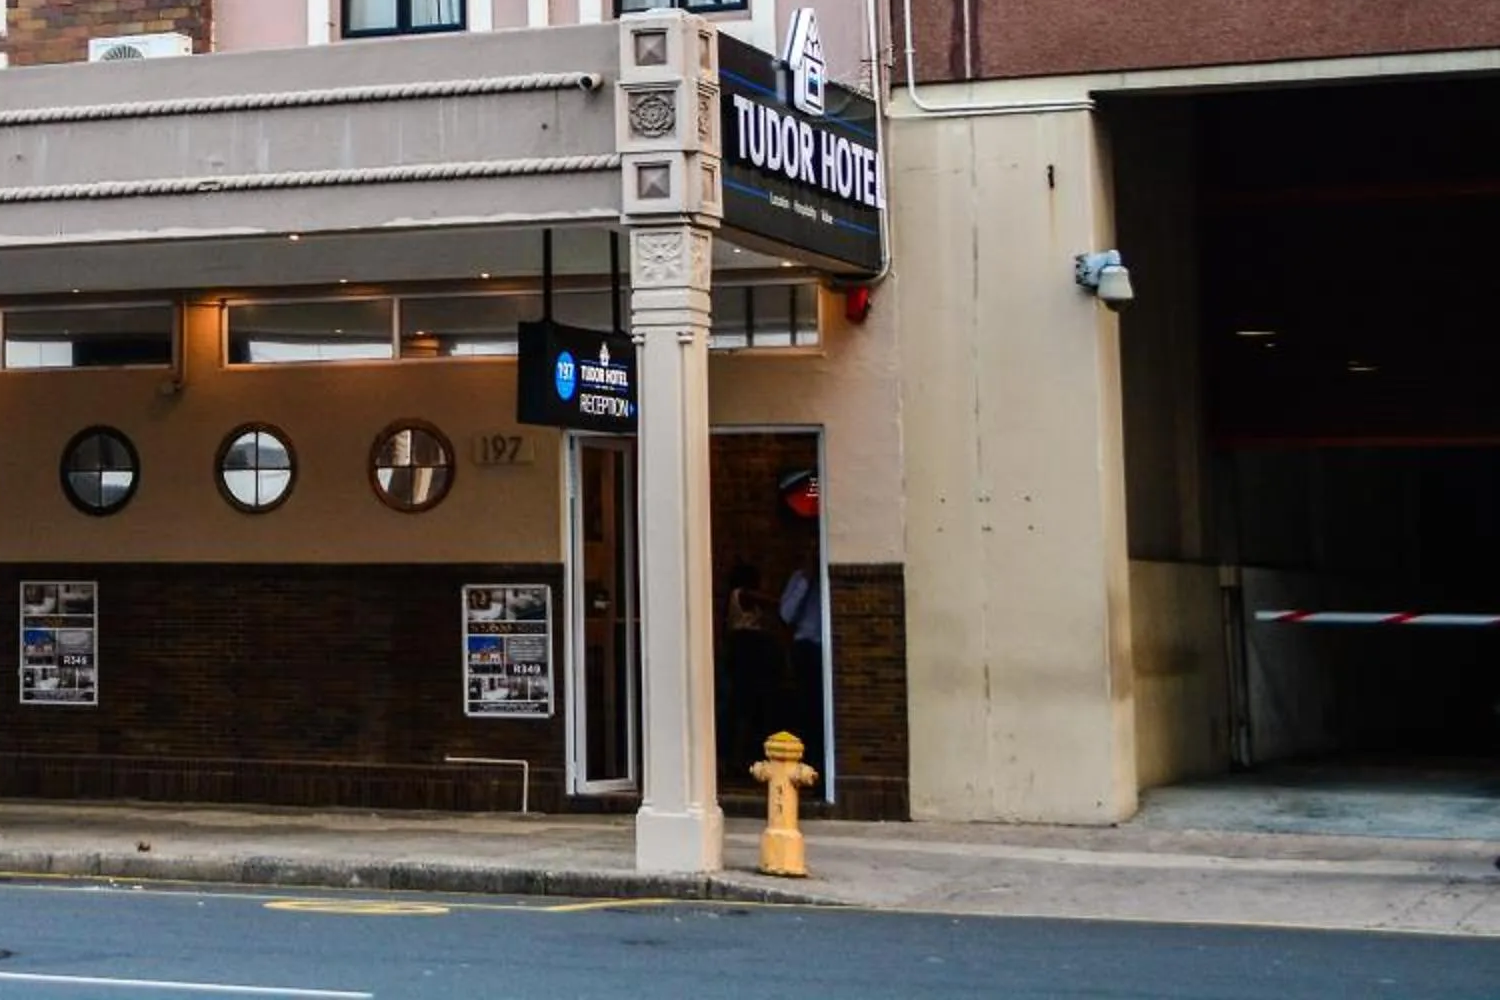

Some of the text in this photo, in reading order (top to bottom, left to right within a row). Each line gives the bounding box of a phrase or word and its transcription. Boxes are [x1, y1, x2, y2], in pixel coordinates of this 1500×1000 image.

[732, 93, 887, 210] TUDOR HOTEL
[557, 361, 576, 380] 197
[580, 364, 629, 387] TUDOR HOTEL
[579, 393, 629, 418] RECEPTION
[479, 435, 524, 461] 197
